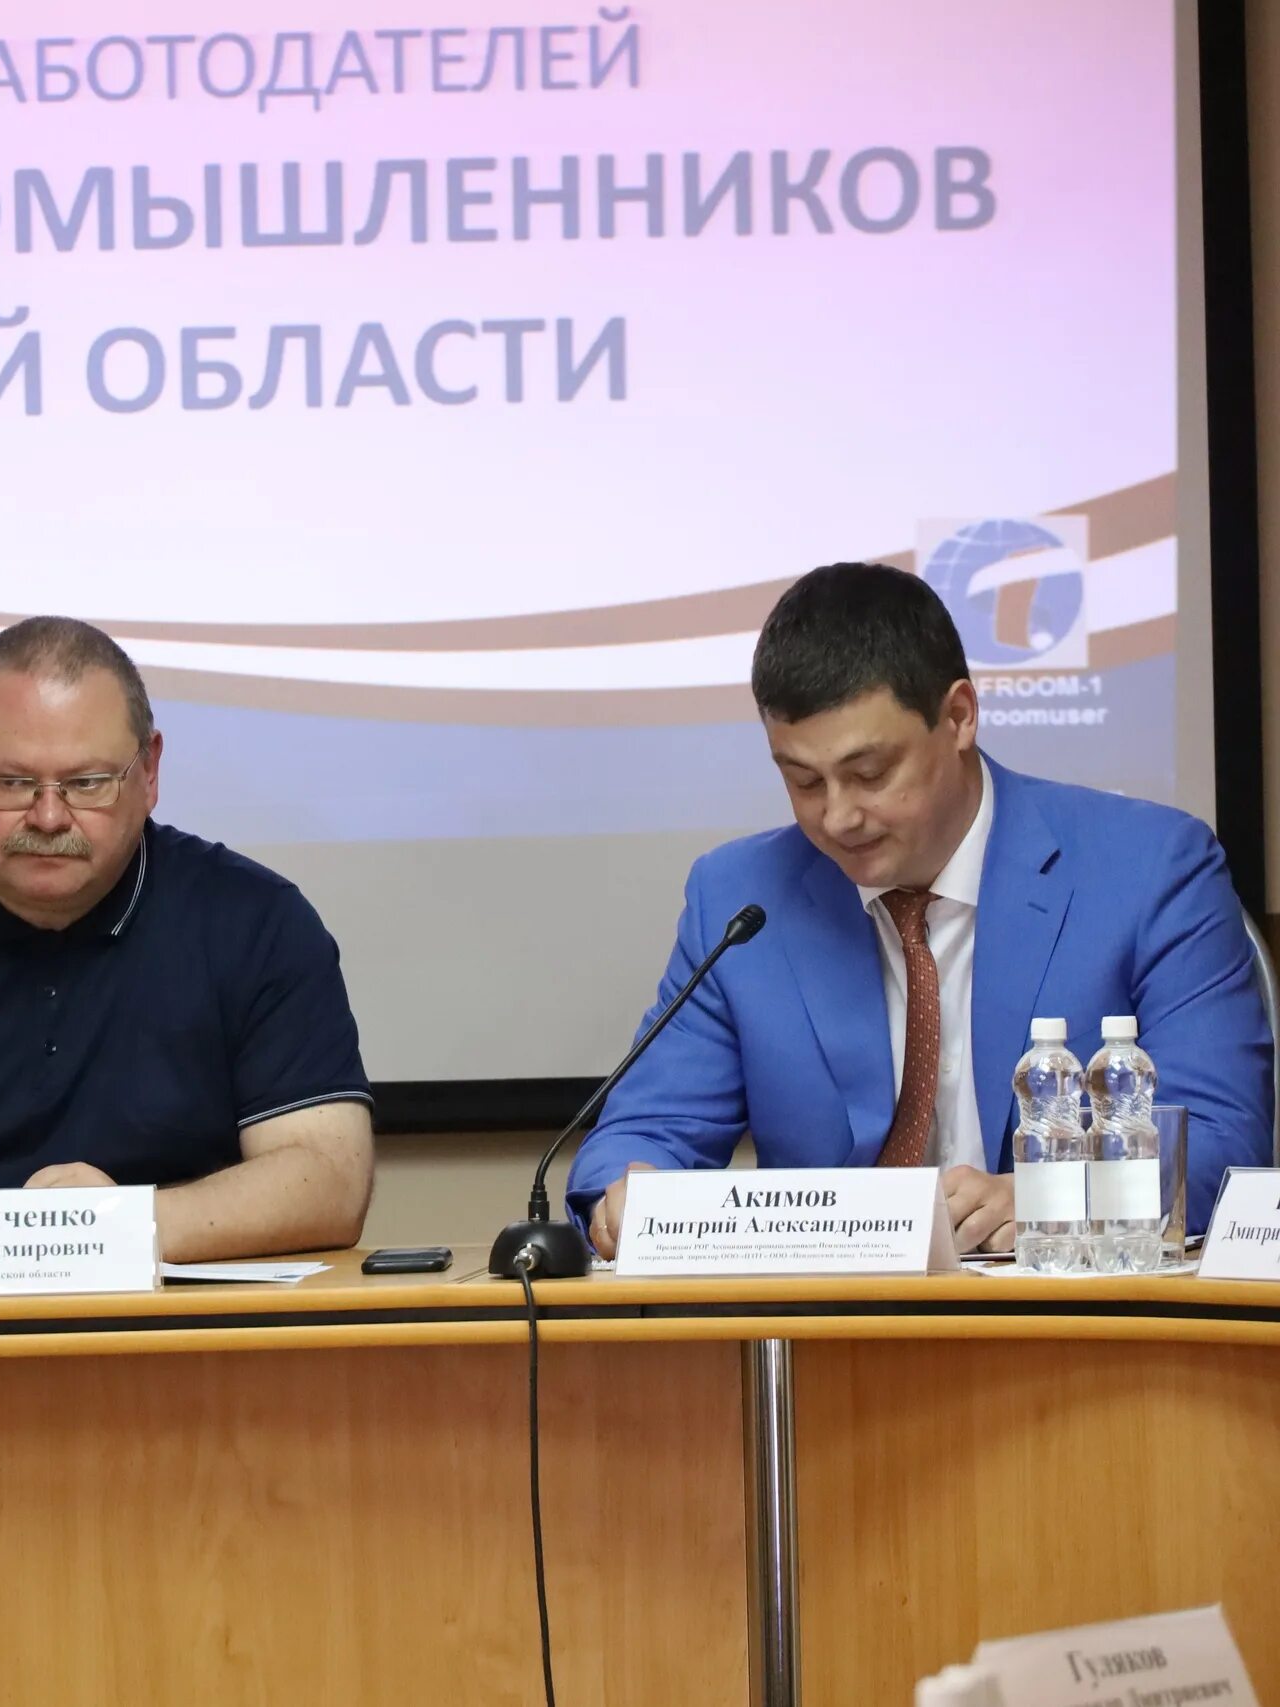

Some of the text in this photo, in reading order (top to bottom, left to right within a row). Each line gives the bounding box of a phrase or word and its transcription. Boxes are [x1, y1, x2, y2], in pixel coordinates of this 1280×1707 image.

[86, 315, 628, 414] ОБЛАСТИ
[977, 675, 1102, 697] FROOM-1
[979, 707, 1108, 726] roomuser
[721, 1185, 837, 1208] Акимов
[637, 1216, 913, 1239] Дмитрий Александрович
[1222, 1220, 1280, 1246] Дмитри
